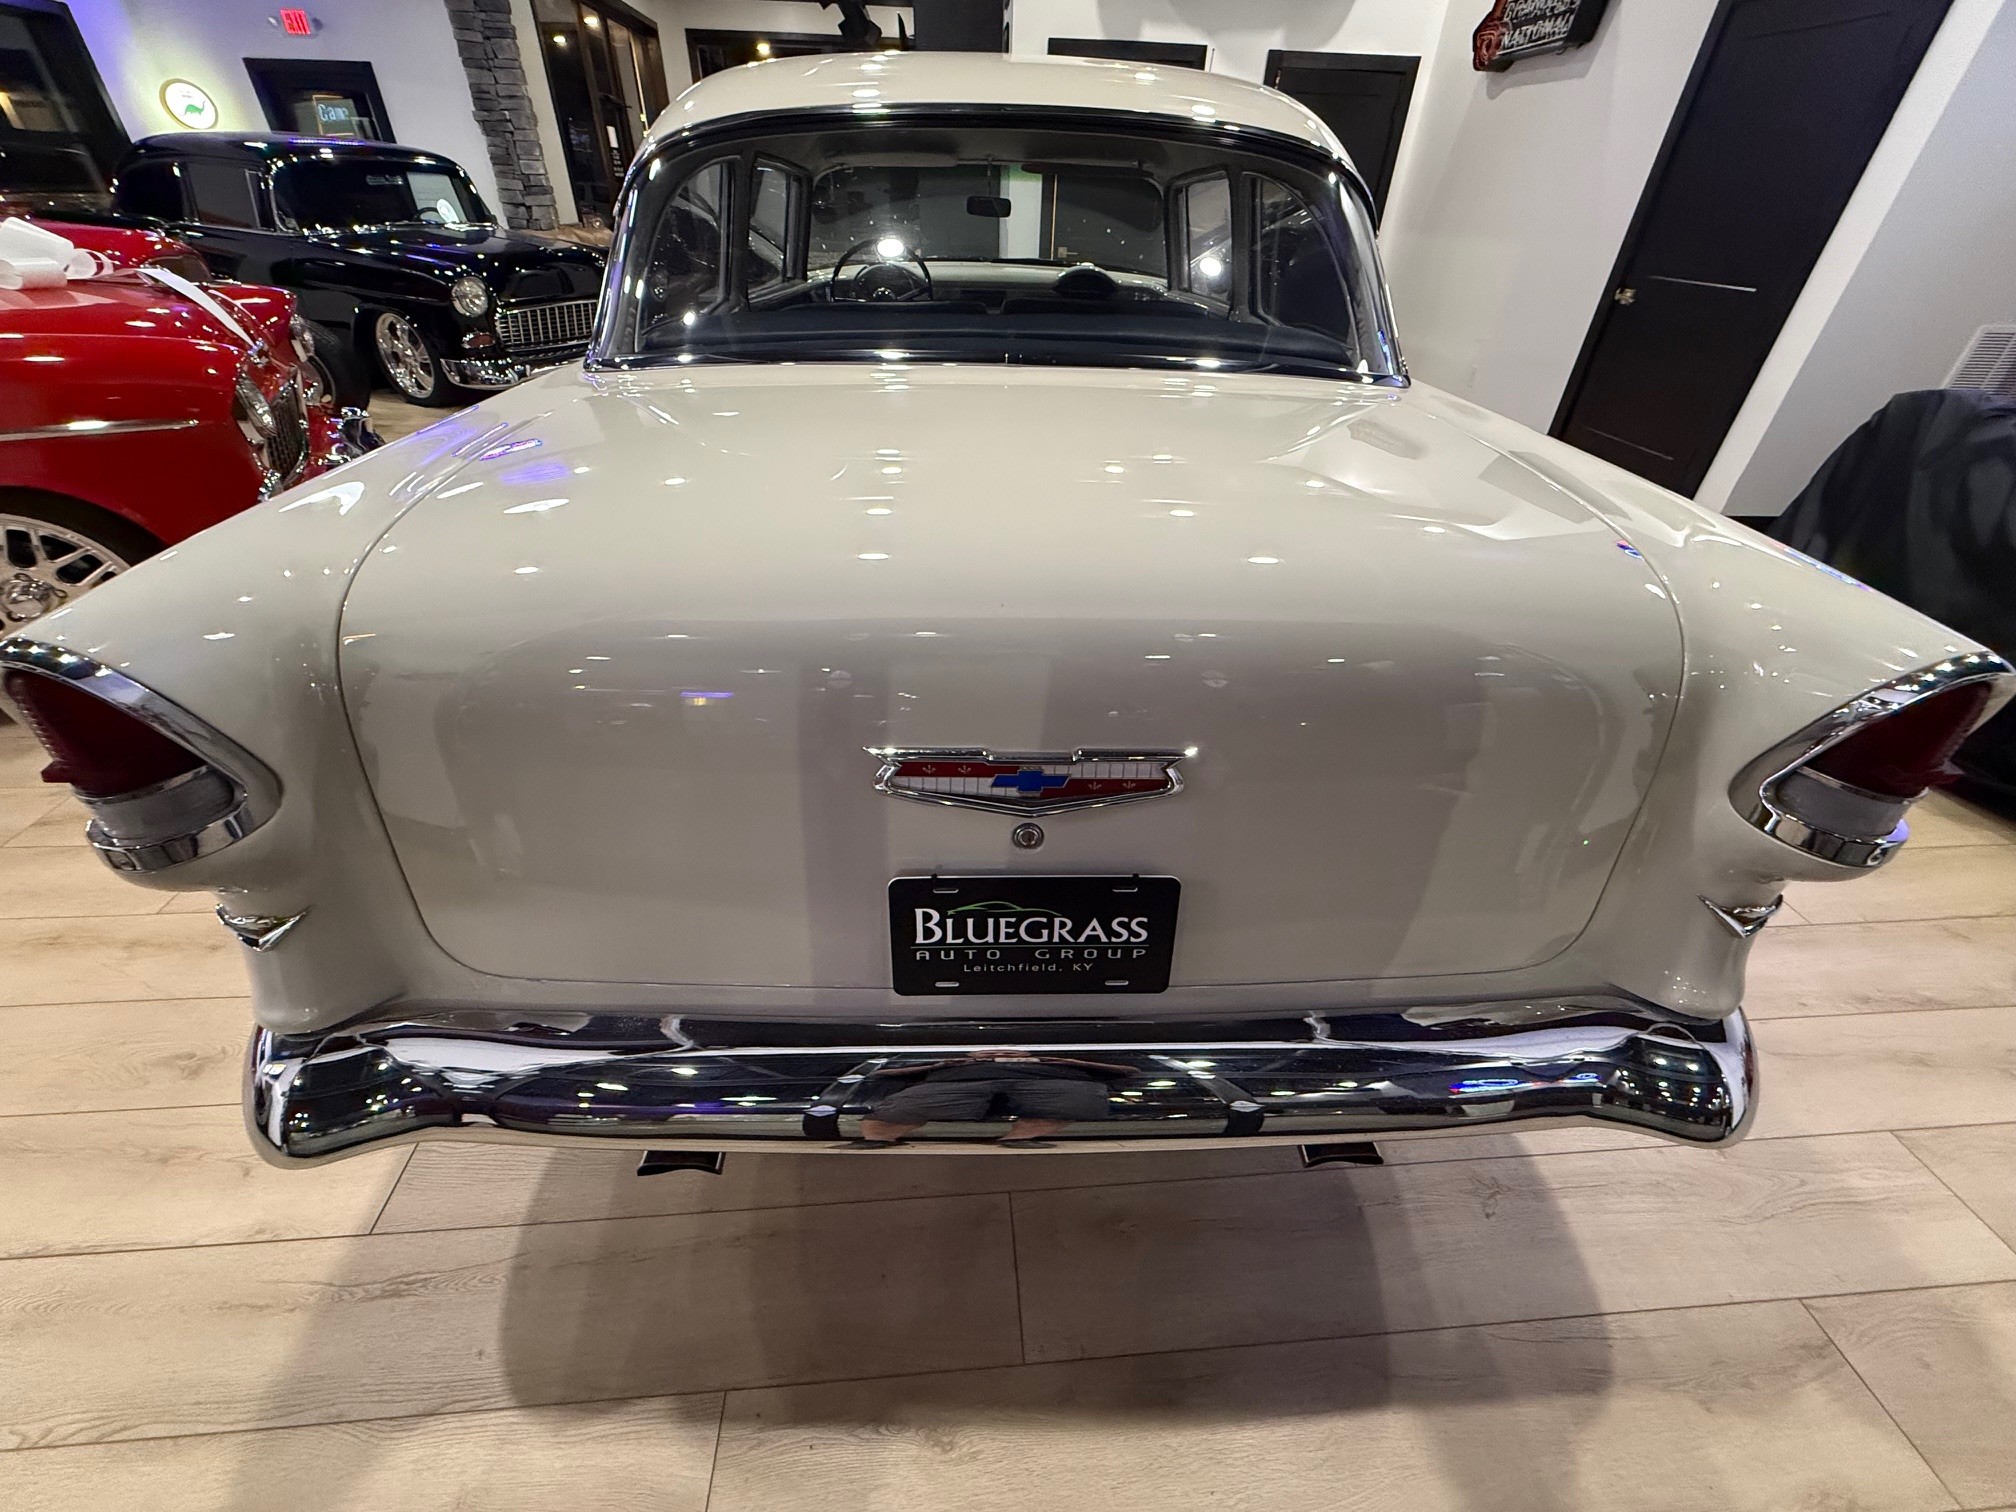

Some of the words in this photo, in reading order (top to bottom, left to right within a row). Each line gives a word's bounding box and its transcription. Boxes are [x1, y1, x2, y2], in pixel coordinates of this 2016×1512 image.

[282, 11, 310, 34] EXIT
[914, 908, 1148, 944] BLUEGRASS
[916, 949, 1000, 961] AUTO
[1034, 948, 1146, 959] GROUP
[963, 963, 1063, 972] Leitchfield,
[1073, 963, 1093, 971] KY
